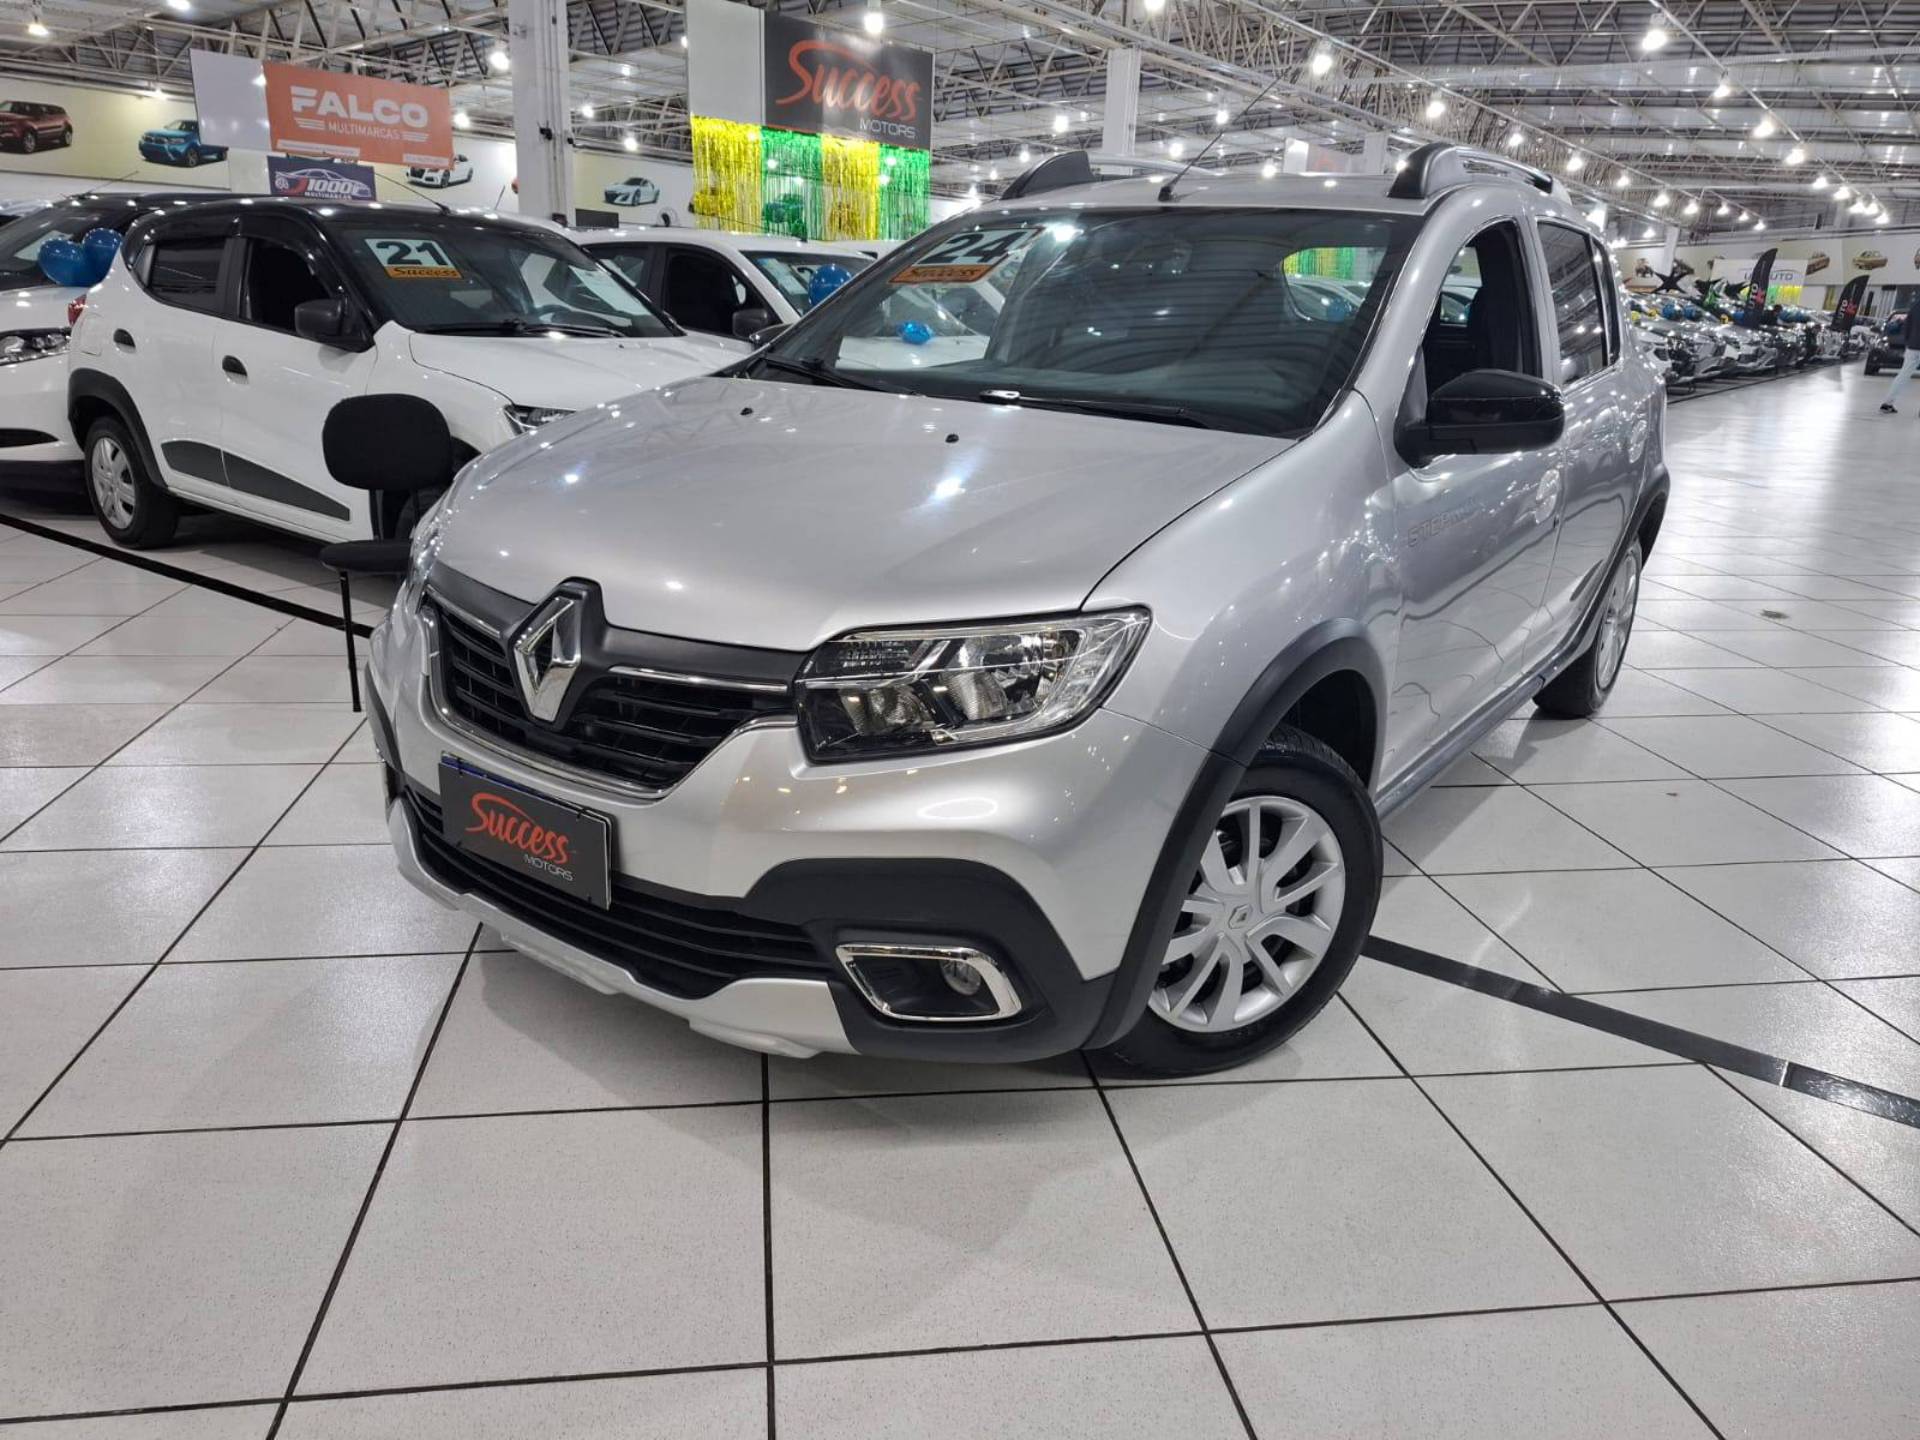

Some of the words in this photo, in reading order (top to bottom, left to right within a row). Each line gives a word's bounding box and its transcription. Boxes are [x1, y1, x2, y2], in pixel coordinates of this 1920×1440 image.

[775, 39, 921, 122] Success
[290, 86, 428, 128] FALCO
[327, 121, 401, 140] MULTIMARCAS
[859, 118, 917, 139] MOTORS
[376, 241, 448, 266] 21
[917, 231, 1028, 264] 24
[388, 266, 459, 277] Success
[464, 792, 569, 864] Success
[523, 853, 575, 882] MOTORS
